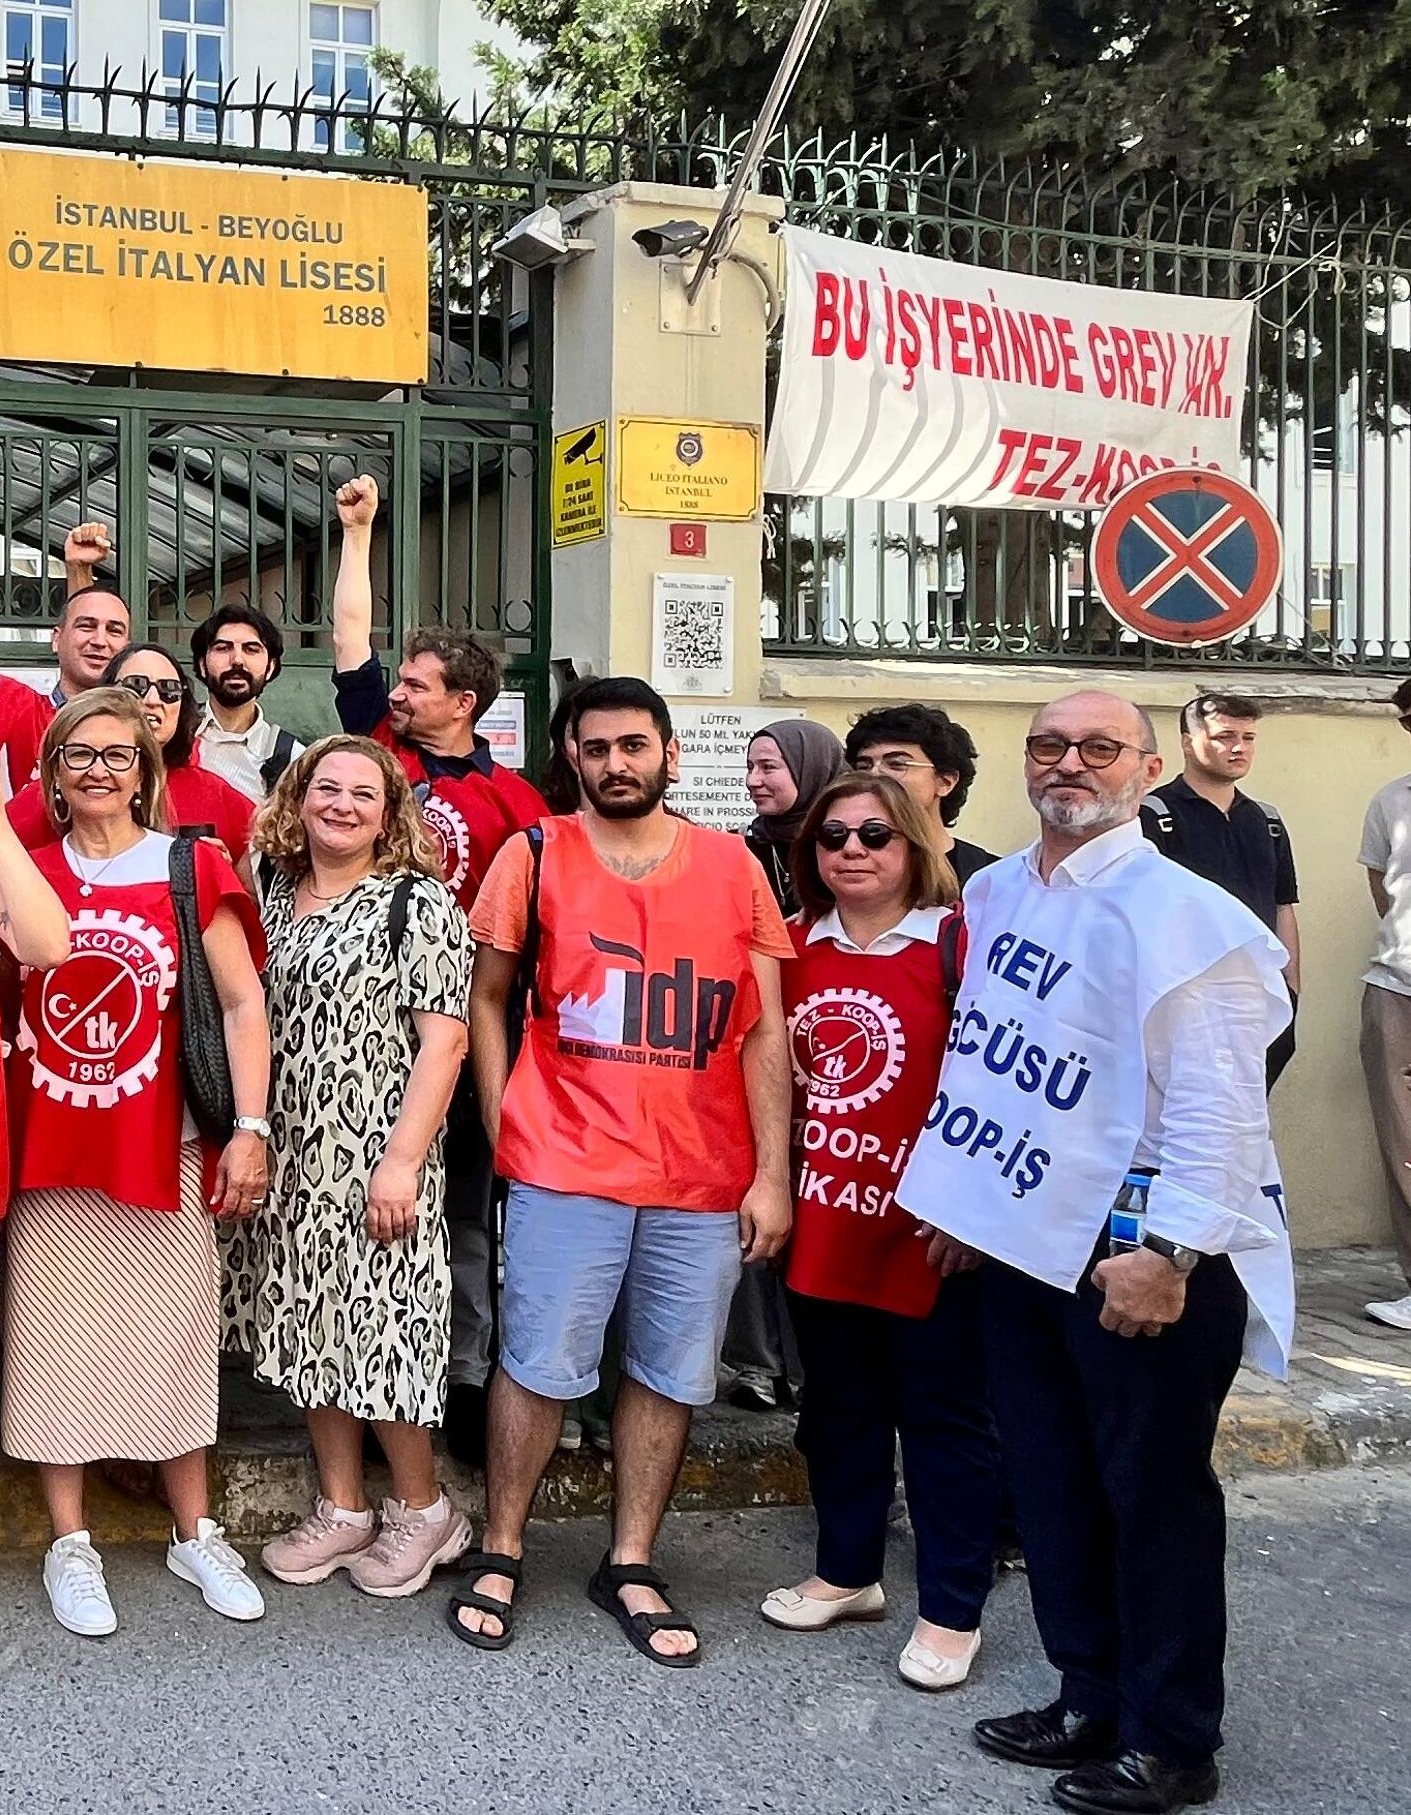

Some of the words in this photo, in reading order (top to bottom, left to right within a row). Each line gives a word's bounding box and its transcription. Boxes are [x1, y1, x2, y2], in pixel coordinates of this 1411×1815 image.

[55, 195, 193, 236] İSTANBUL
[218, 213, 344, 245] BEYOĞLU
[8, 231, 104, 276] ÖZEL
[117, 238, 266, 287] İTALYAN
[280, 251, 387, 294] LİSESİ
[323, 304, 386, 328] 1888
[812, 271, 870, 361] BU
[879, 267, 1084, 392] İŞYERİNDE
[1087, 321, 1176, 412] GREV
[650, 472, 680, 483] LICEO
[682, 473, 728, 486] ITALIANO
[684, 531, 695, 548] 3
[701, 713, 741, 725] LÜTFEN
[675, 729, 696, 739] LUN
[699, 729, 711, 739] 50
[682, 744, 711, 754] GARA
[714, 743, 747, 755] İÇMEY
[664, 791, 742, 802] ORTESEMENTE
[717, 807, 755, 817] PROSSI
[85, 1011, 118, 1048] tk
[796, 1009, 821, 1036] TEZ
[807, 1079, 840, 1097] 962
